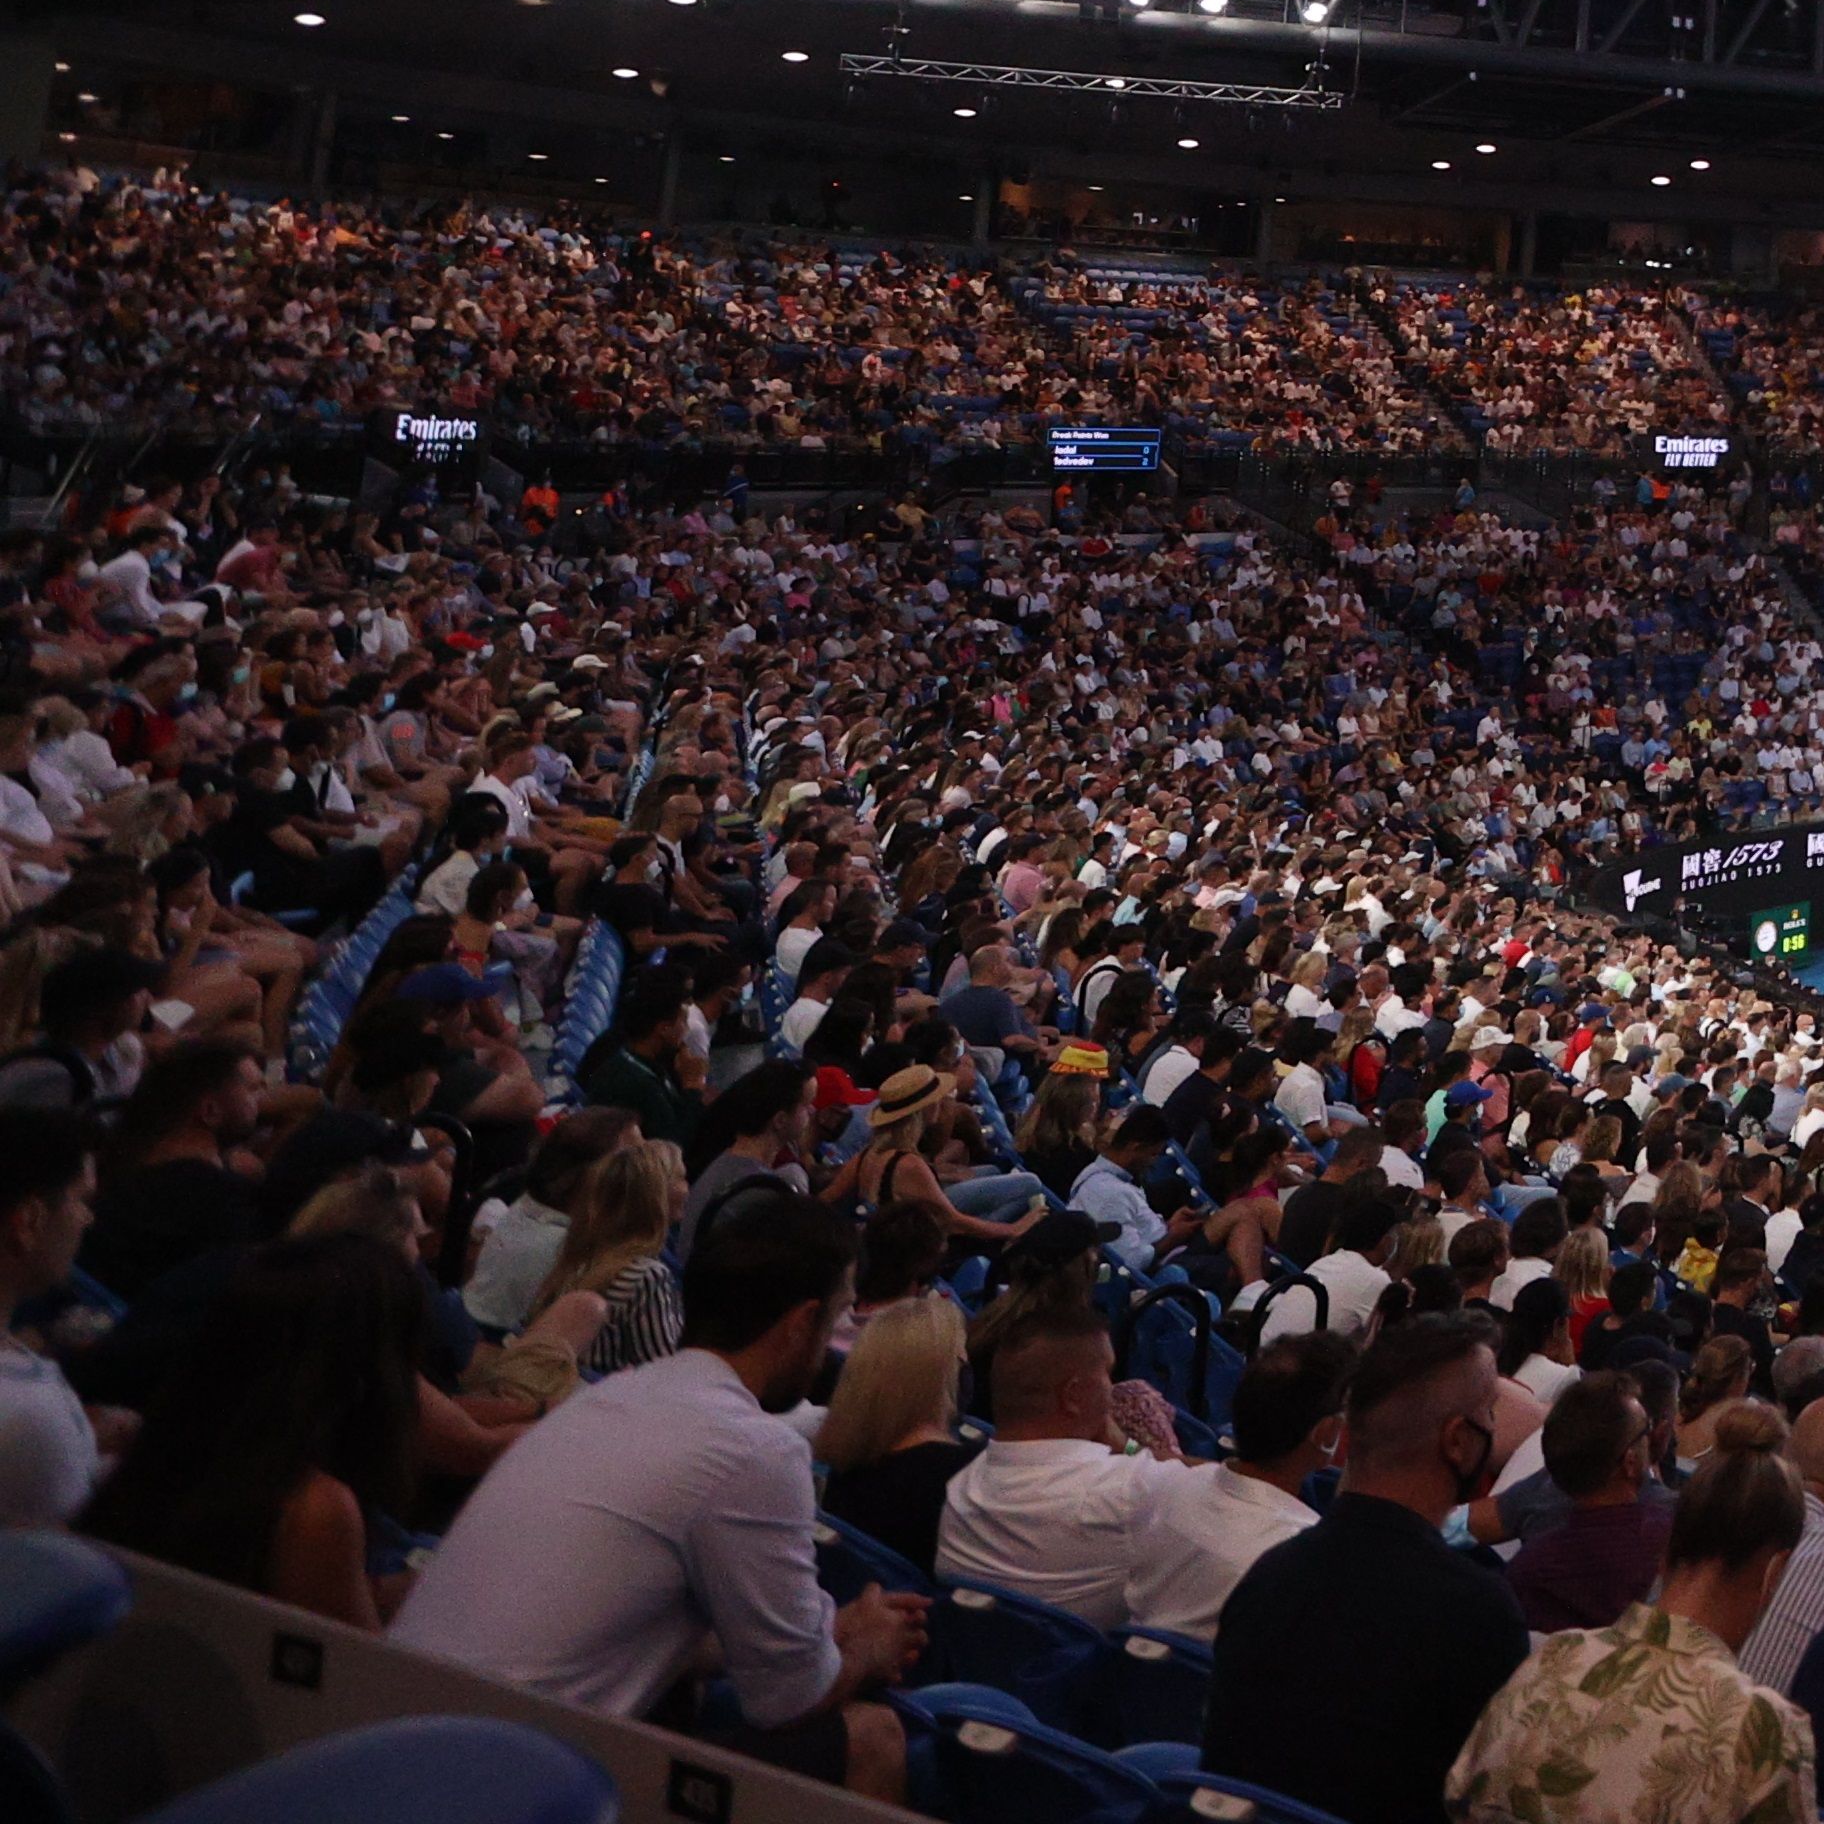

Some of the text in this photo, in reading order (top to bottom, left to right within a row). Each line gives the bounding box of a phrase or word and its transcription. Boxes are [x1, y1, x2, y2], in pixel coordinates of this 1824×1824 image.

[396, 413, 476, 440] Emirates
[1655, 435, 1729, 453] Emirates
[1664, 453, 1718, 467] FLY BETTER
[1681, 863, 1782, 892] GUOJIAO 1573
[1783, 934, 1805, 953] 0:56
